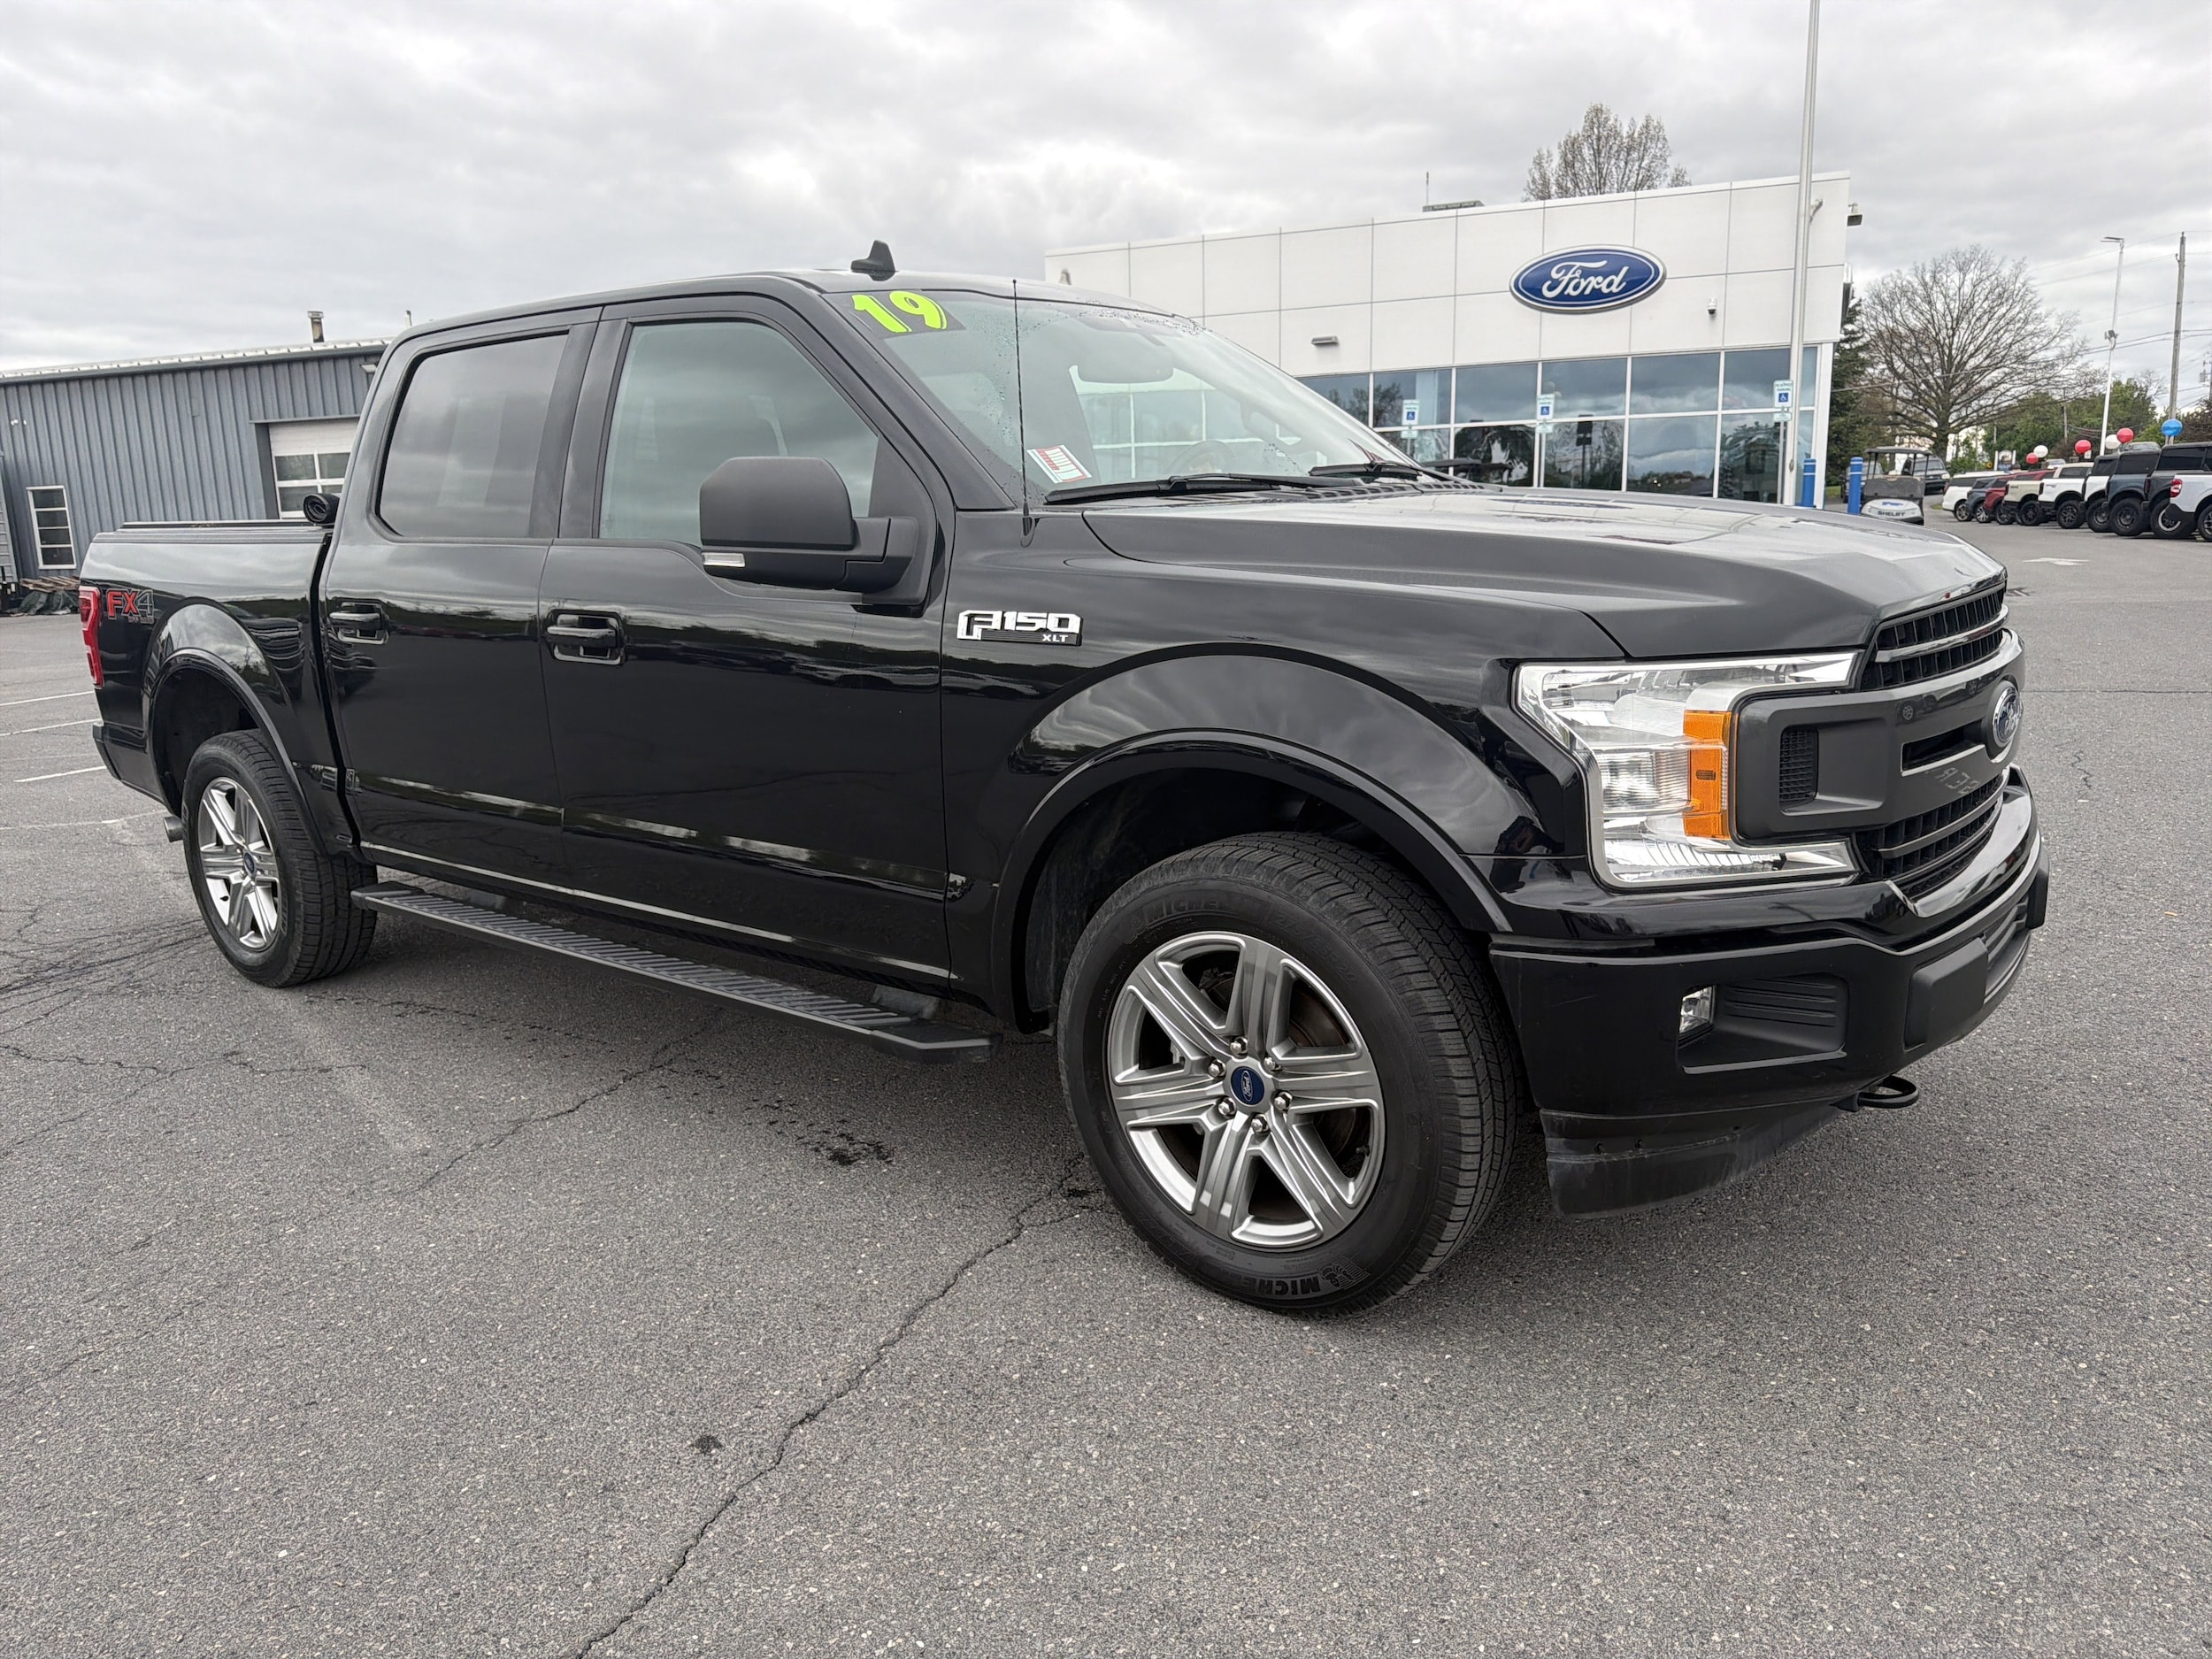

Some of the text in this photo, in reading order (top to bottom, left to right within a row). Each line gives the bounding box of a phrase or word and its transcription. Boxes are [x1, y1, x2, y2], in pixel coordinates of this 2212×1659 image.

[1542, 260, 1629, 298] Ford
[851, 290, 947, 333] 19
[106, 588, 154, 620] FX4
[1042, 634, 1069, 642] XLT
